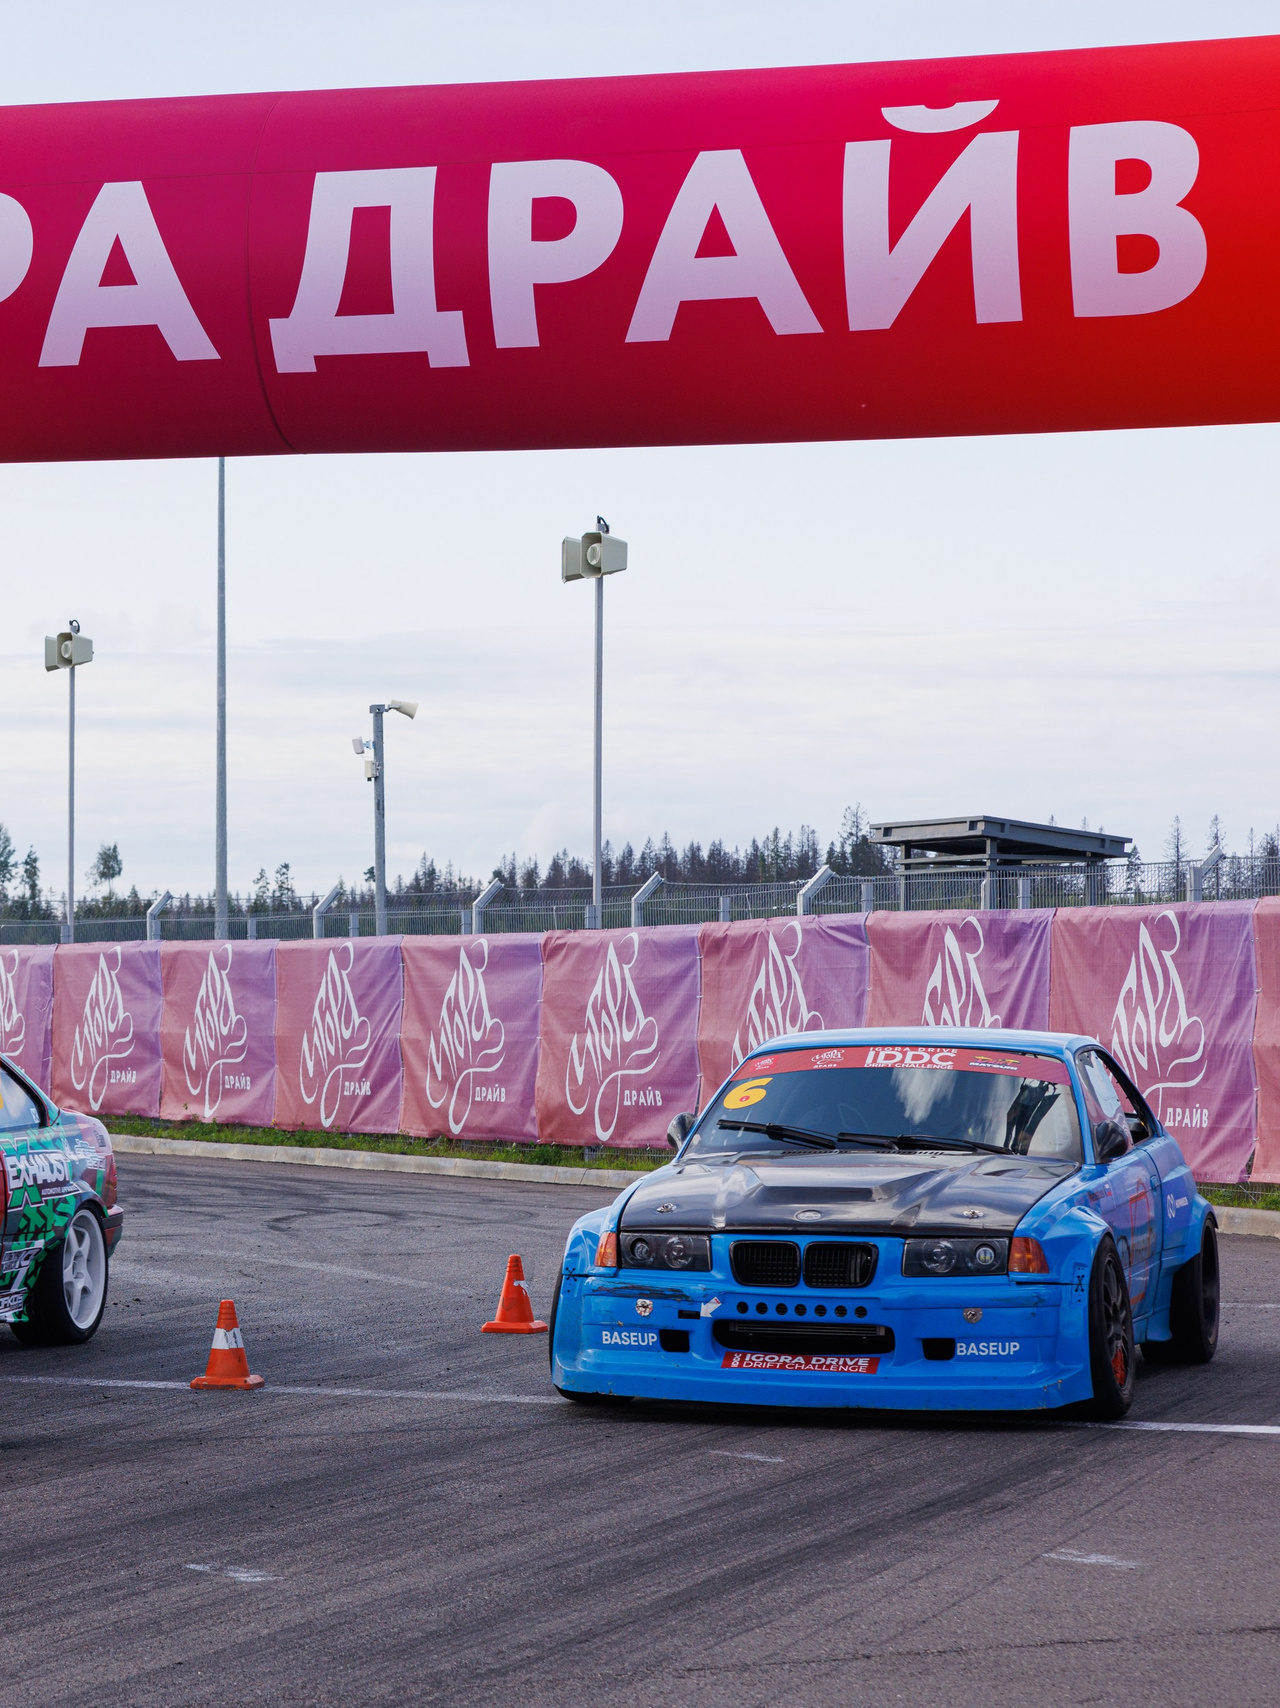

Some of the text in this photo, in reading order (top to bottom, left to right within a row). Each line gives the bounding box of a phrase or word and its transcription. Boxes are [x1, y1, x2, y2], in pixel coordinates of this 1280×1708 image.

[268, 98, 1207, 373] ДРАЙВ
[865, 1051, 956, 1065] IDDC
[110, 1067, 137, 1083] ДРАЙВ
[224, 1073, 251, 1091] ДРАЙВ
[343, 1078, 371, 1096] ДРАЙВ
[474, 1084, 506, 1103] ДРАЙВ
[723, 1078, 773, 1110] 6
[623, 1086, 663, 1107] ДРАЙВ
[1164, 1103, 1208, 1128] ДРАЙВ
[601, 1331, 658, 1346] BASEUP
[956, 1341, 1020, 1356] BASEUP
[742, 1361, 868, 1373] DRIFT CHALLENGE
[744, 1353, 806, 1364] IGORA
[811, 1356, 870, 1366] DRIVE
